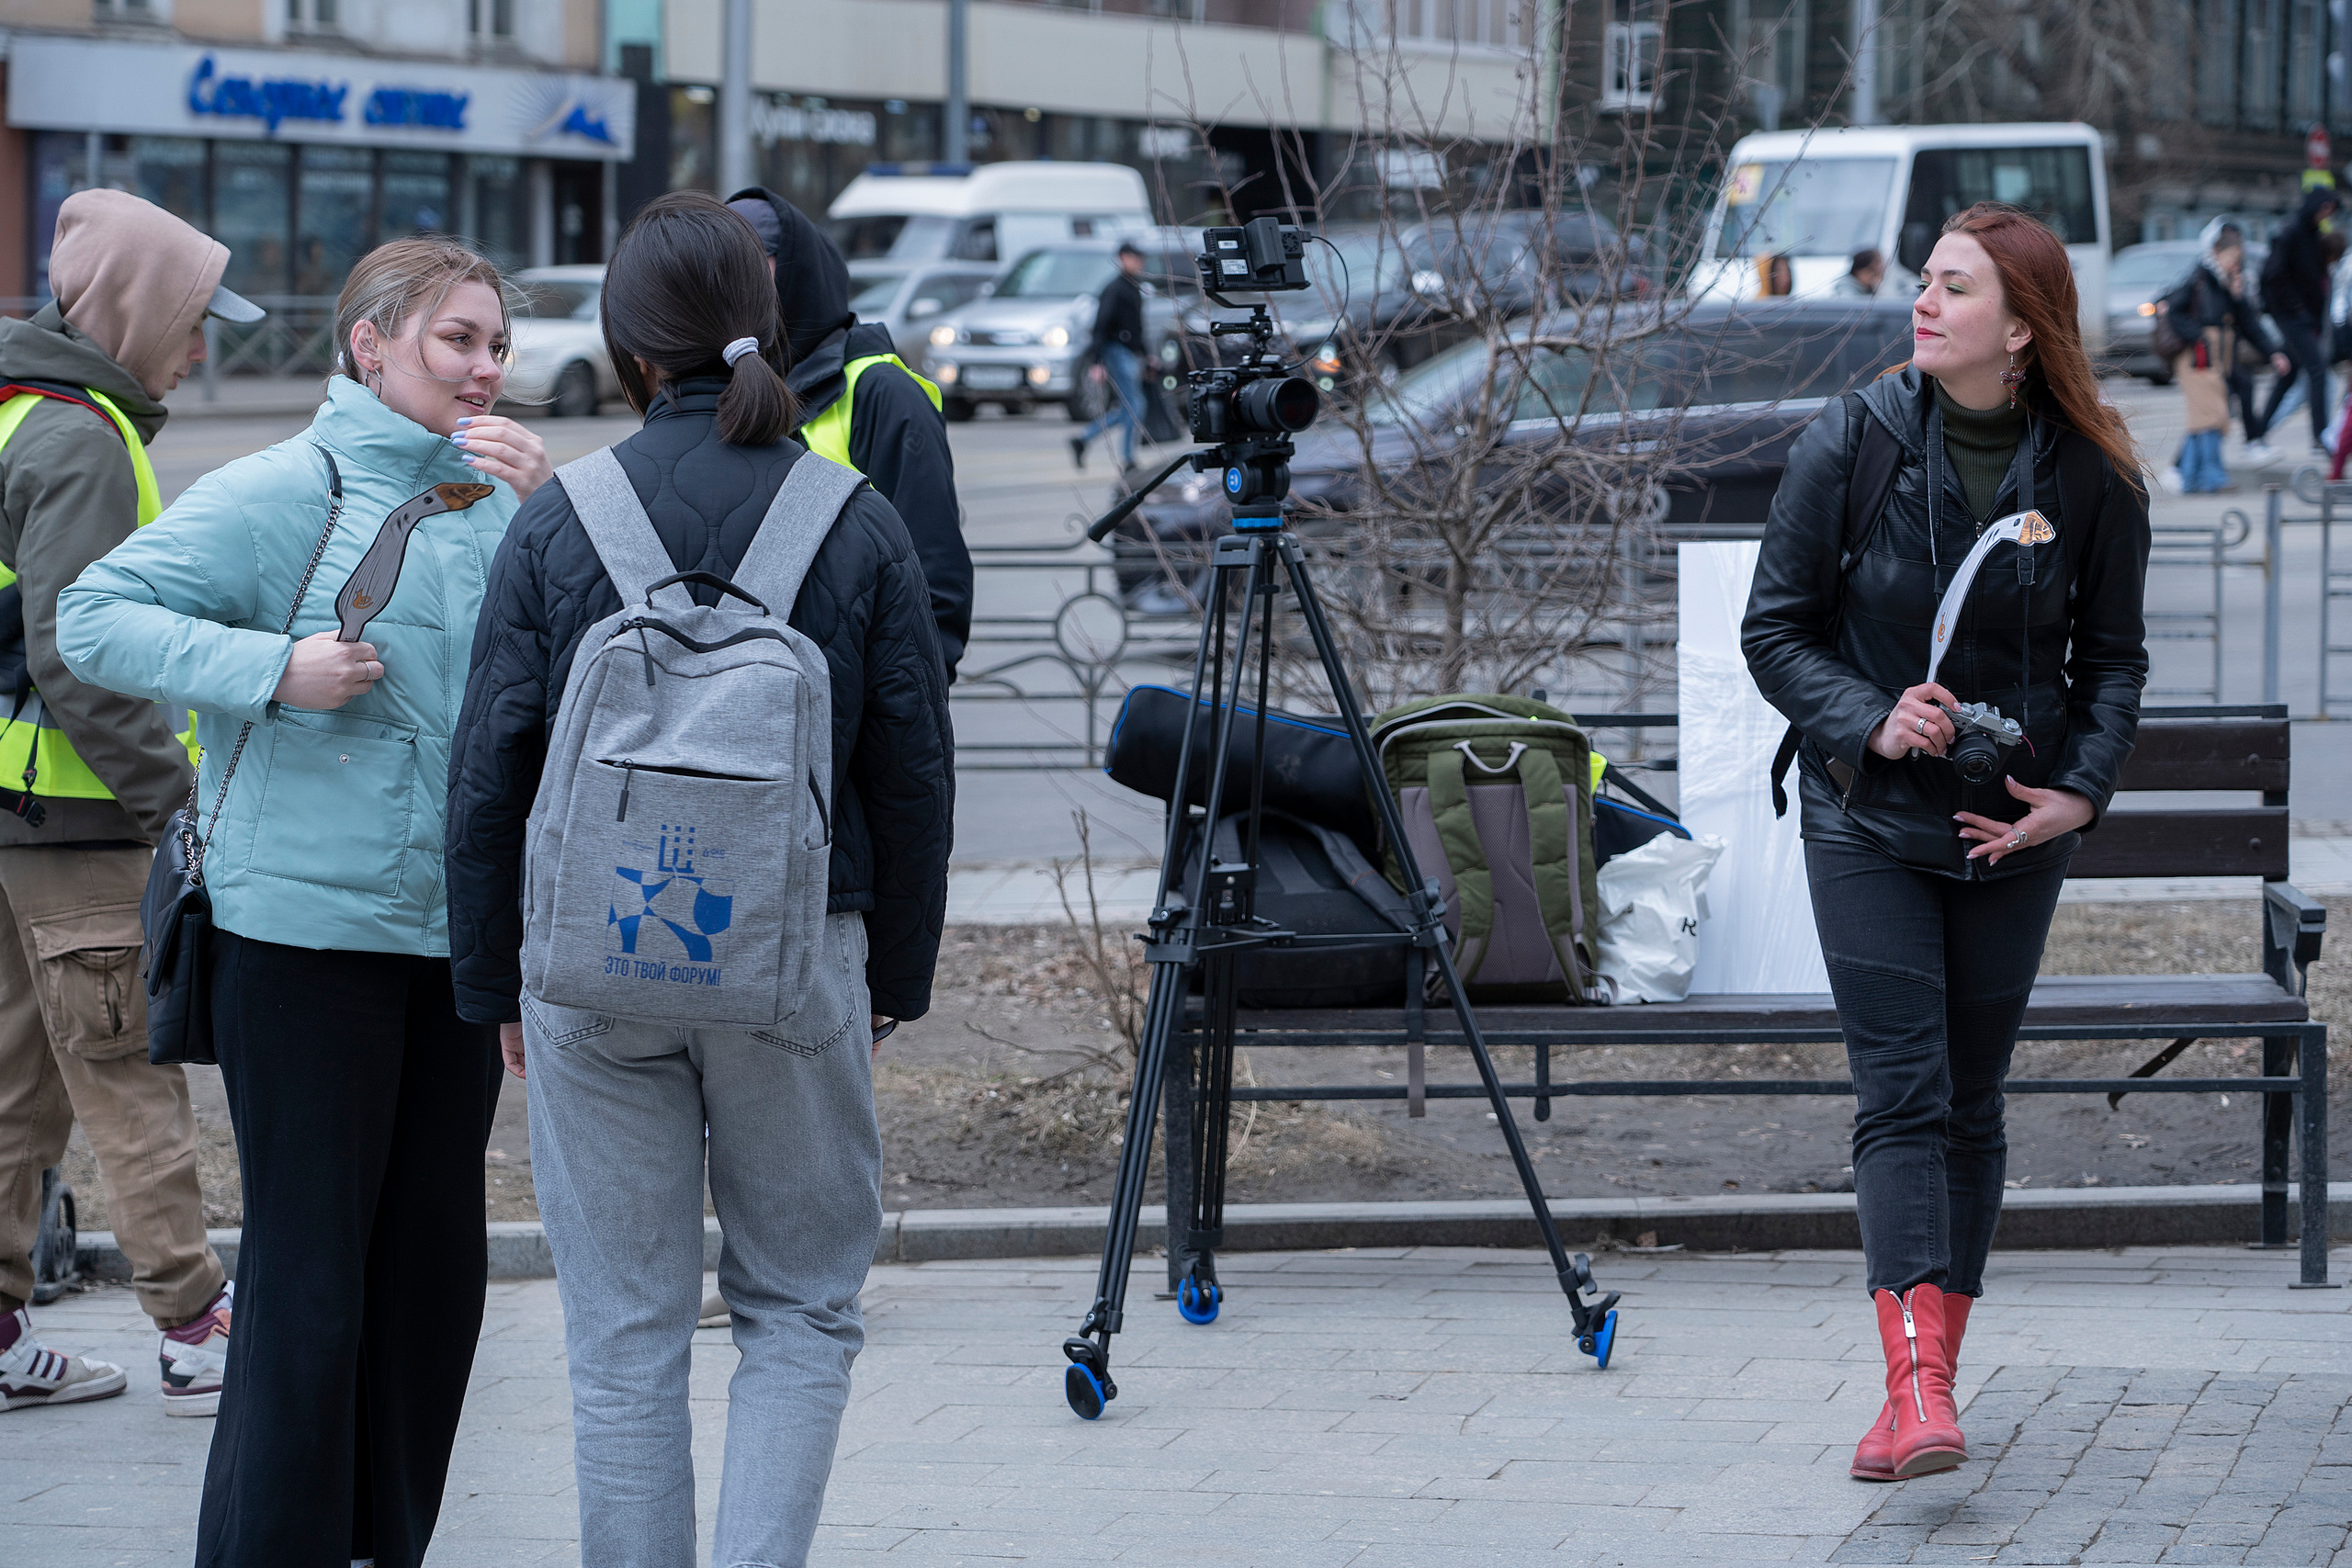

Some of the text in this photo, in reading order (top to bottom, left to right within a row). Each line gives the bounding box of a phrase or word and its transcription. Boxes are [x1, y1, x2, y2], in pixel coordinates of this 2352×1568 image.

[605, 955, 721, 987] ЭТО ТВОЙ ФОРУМ!
